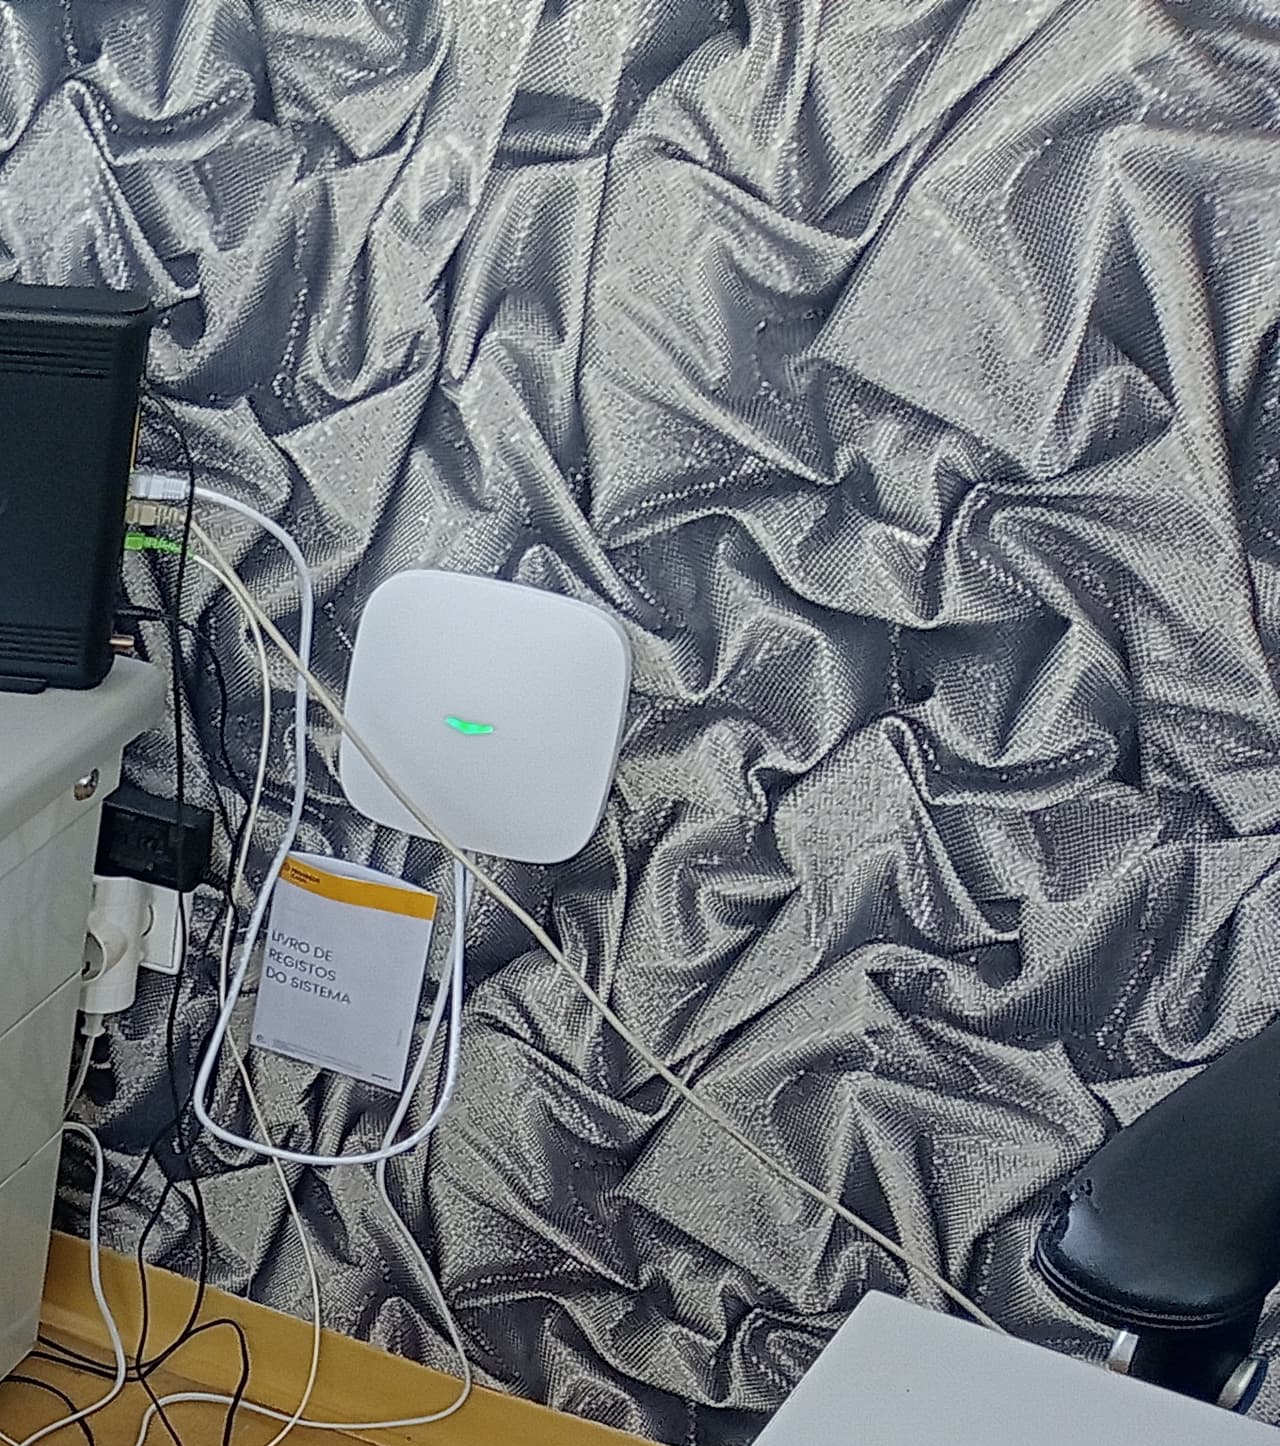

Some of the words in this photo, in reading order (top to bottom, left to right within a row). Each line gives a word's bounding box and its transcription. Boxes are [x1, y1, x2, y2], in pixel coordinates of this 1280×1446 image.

[271, 929, 311, 955] LIVRO
[313, 945, 335, 964] DE
[268, 947, 337, 983] REGISTOS
[265, 965, 288, 985] DO
[289, 976, 352, 1006] SISTEMA
